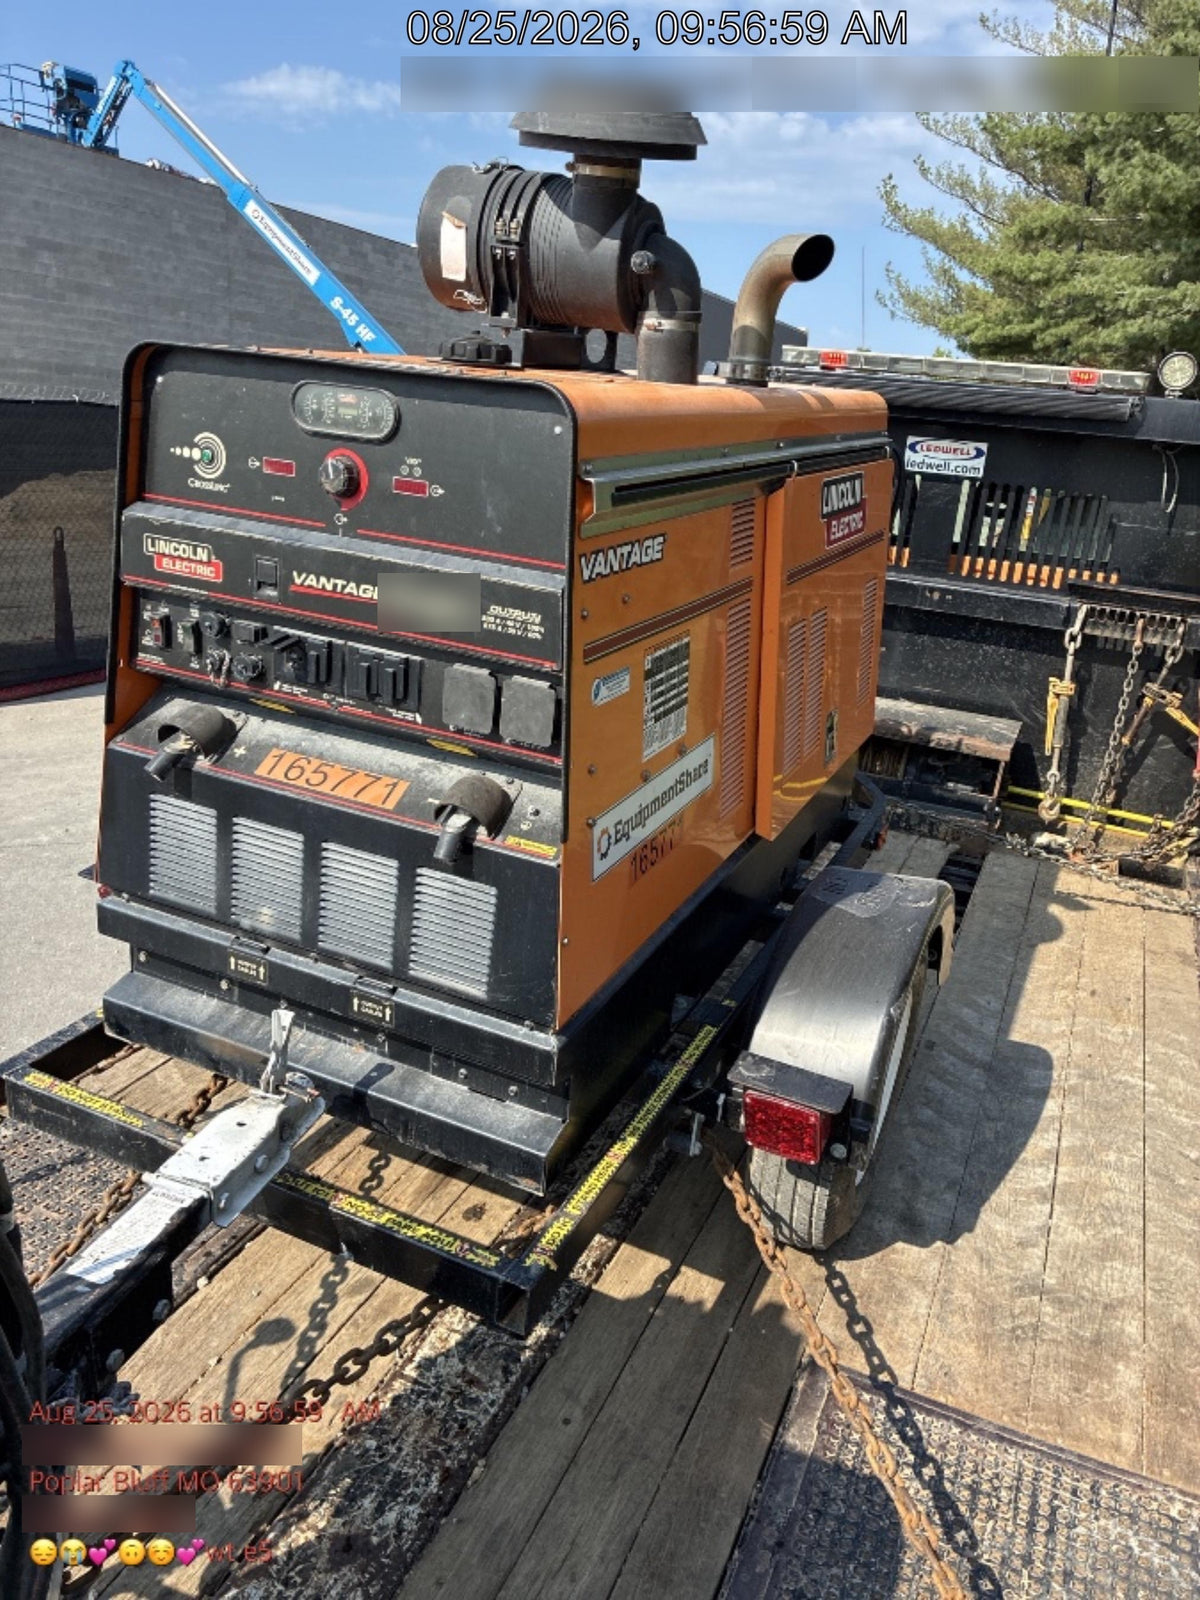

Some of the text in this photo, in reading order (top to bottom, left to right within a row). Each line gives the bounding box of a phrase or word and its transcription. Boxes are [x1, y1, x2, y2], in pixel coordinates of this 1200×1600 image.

[330, 296, 377, 342] S-45 HF
[920, 444, 972, 456] LEDWELL
[906, 458, 981, 475] ledwell.com
[823, 478, 861, 514] LINCOLN
[830, 510, 863, 540] ELECTRIC
[147, 537, 209, 562] LINCOLN
[580, 535, 666, 582] VANTAGE
[162, 559, 216, 578] ELECTRIC
[487, 605, 541, 624] OUTPUT
[266, 750, 400, 806] 165771
[613, 758, 709, 845] EquipmentShare
